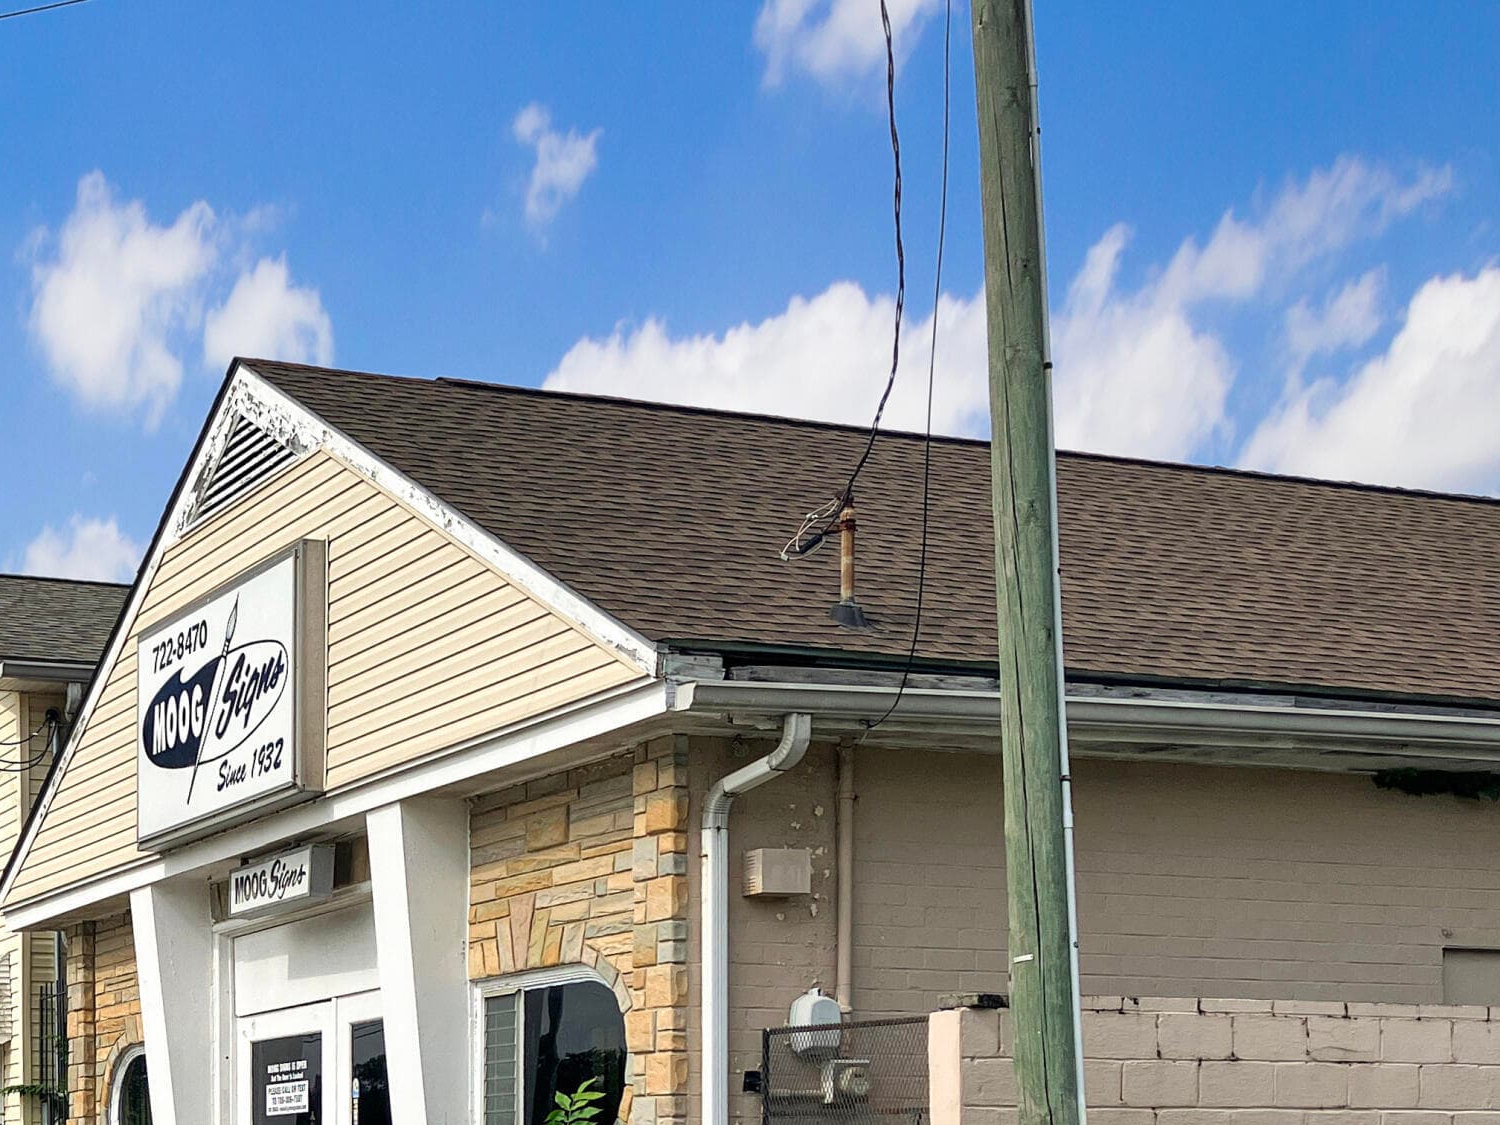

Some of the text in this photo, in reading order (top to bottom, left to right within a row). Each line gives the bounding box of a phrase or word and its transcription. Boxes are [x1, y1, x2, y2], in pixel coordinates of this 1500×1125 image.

[152, 619, 208, 674] 722-8470
[152, 650, 284, 756] MOOG Signs
[217, 737, 284, 792] Since 1932
[235, 859, 306, 904] MOOG Signs
